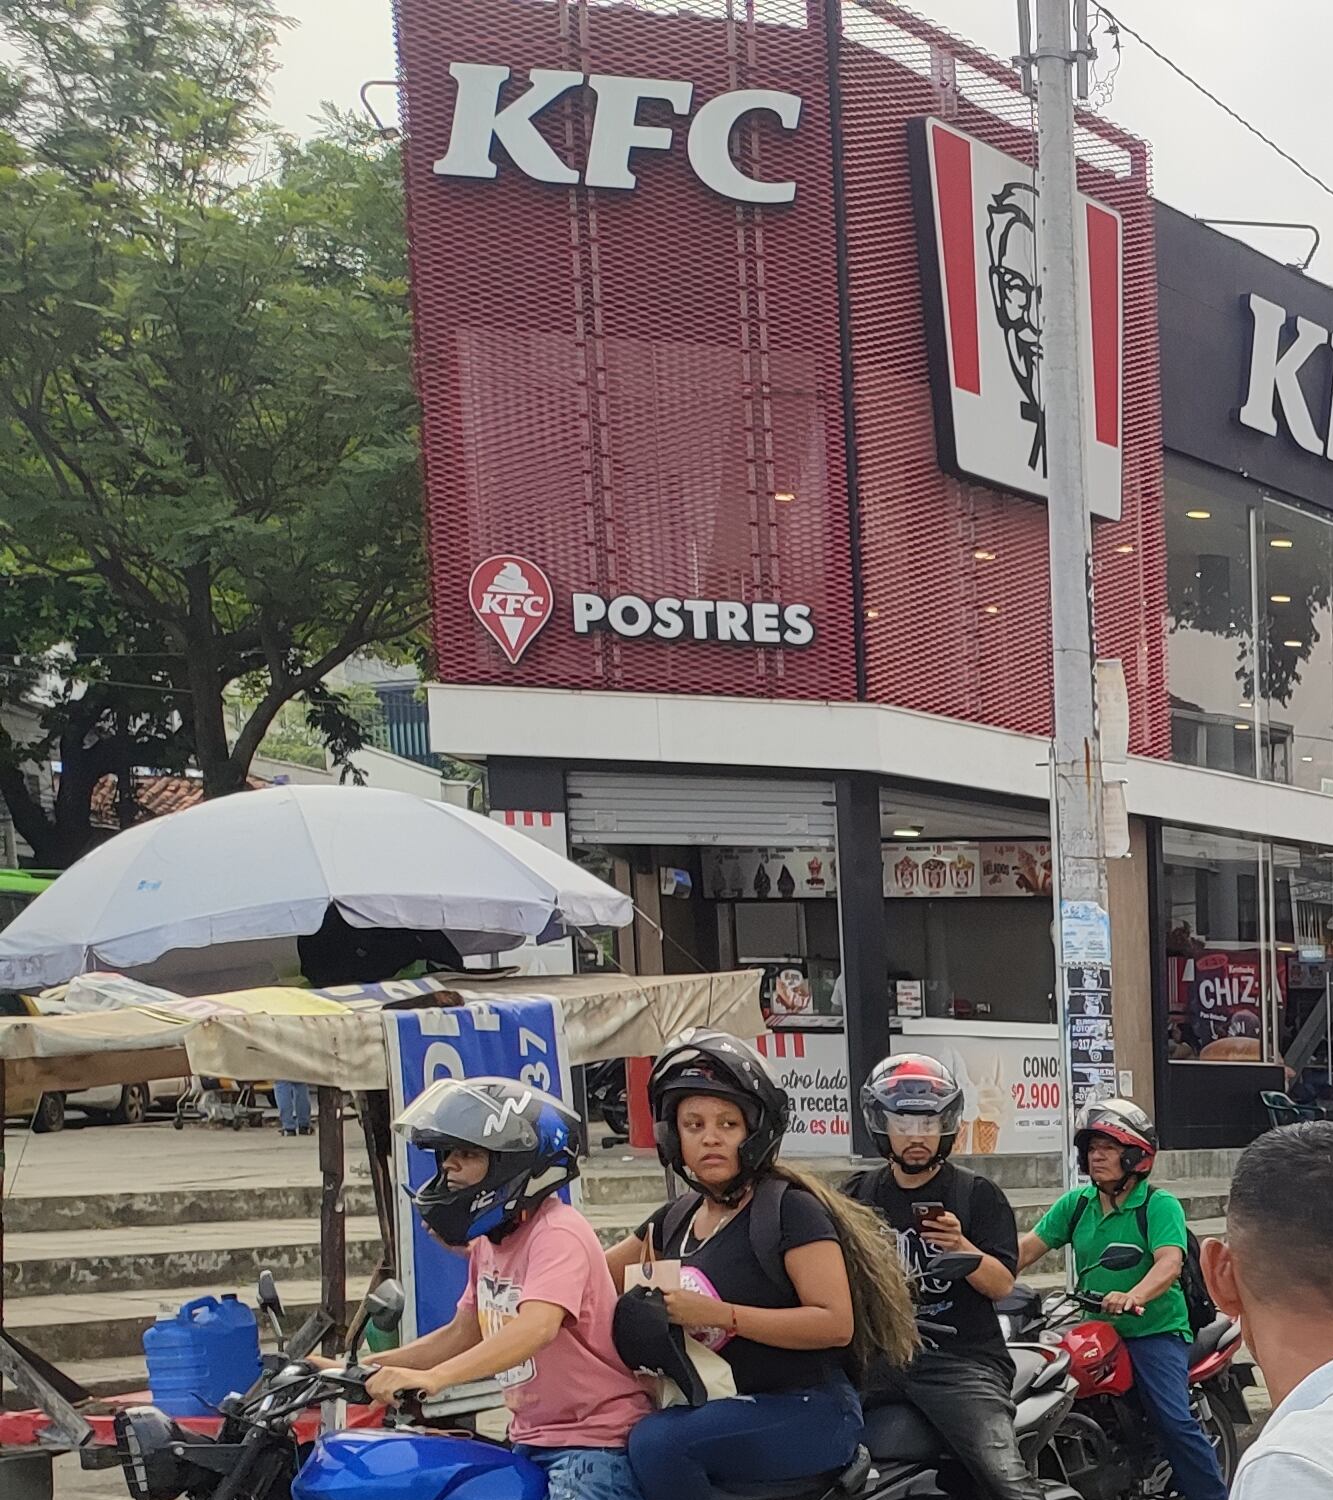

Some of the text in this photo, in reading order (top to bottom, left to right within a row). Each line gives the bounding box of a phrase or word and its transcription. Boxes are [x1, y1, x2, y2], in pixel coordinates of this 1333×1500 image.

[433, 62, 801, 204] KFC
[480, 593, 543, 617] KFC
[573, 593, 814, 646] POSTRES
[1023, 1056, 1061, 1078] CONO
[815, 1068, 848, 1090] lado
[800, 1094, 849, 1113] receta
[1011, 1083, 1060, 1110] $2.900
[809, 1119, 827, 1135] es
